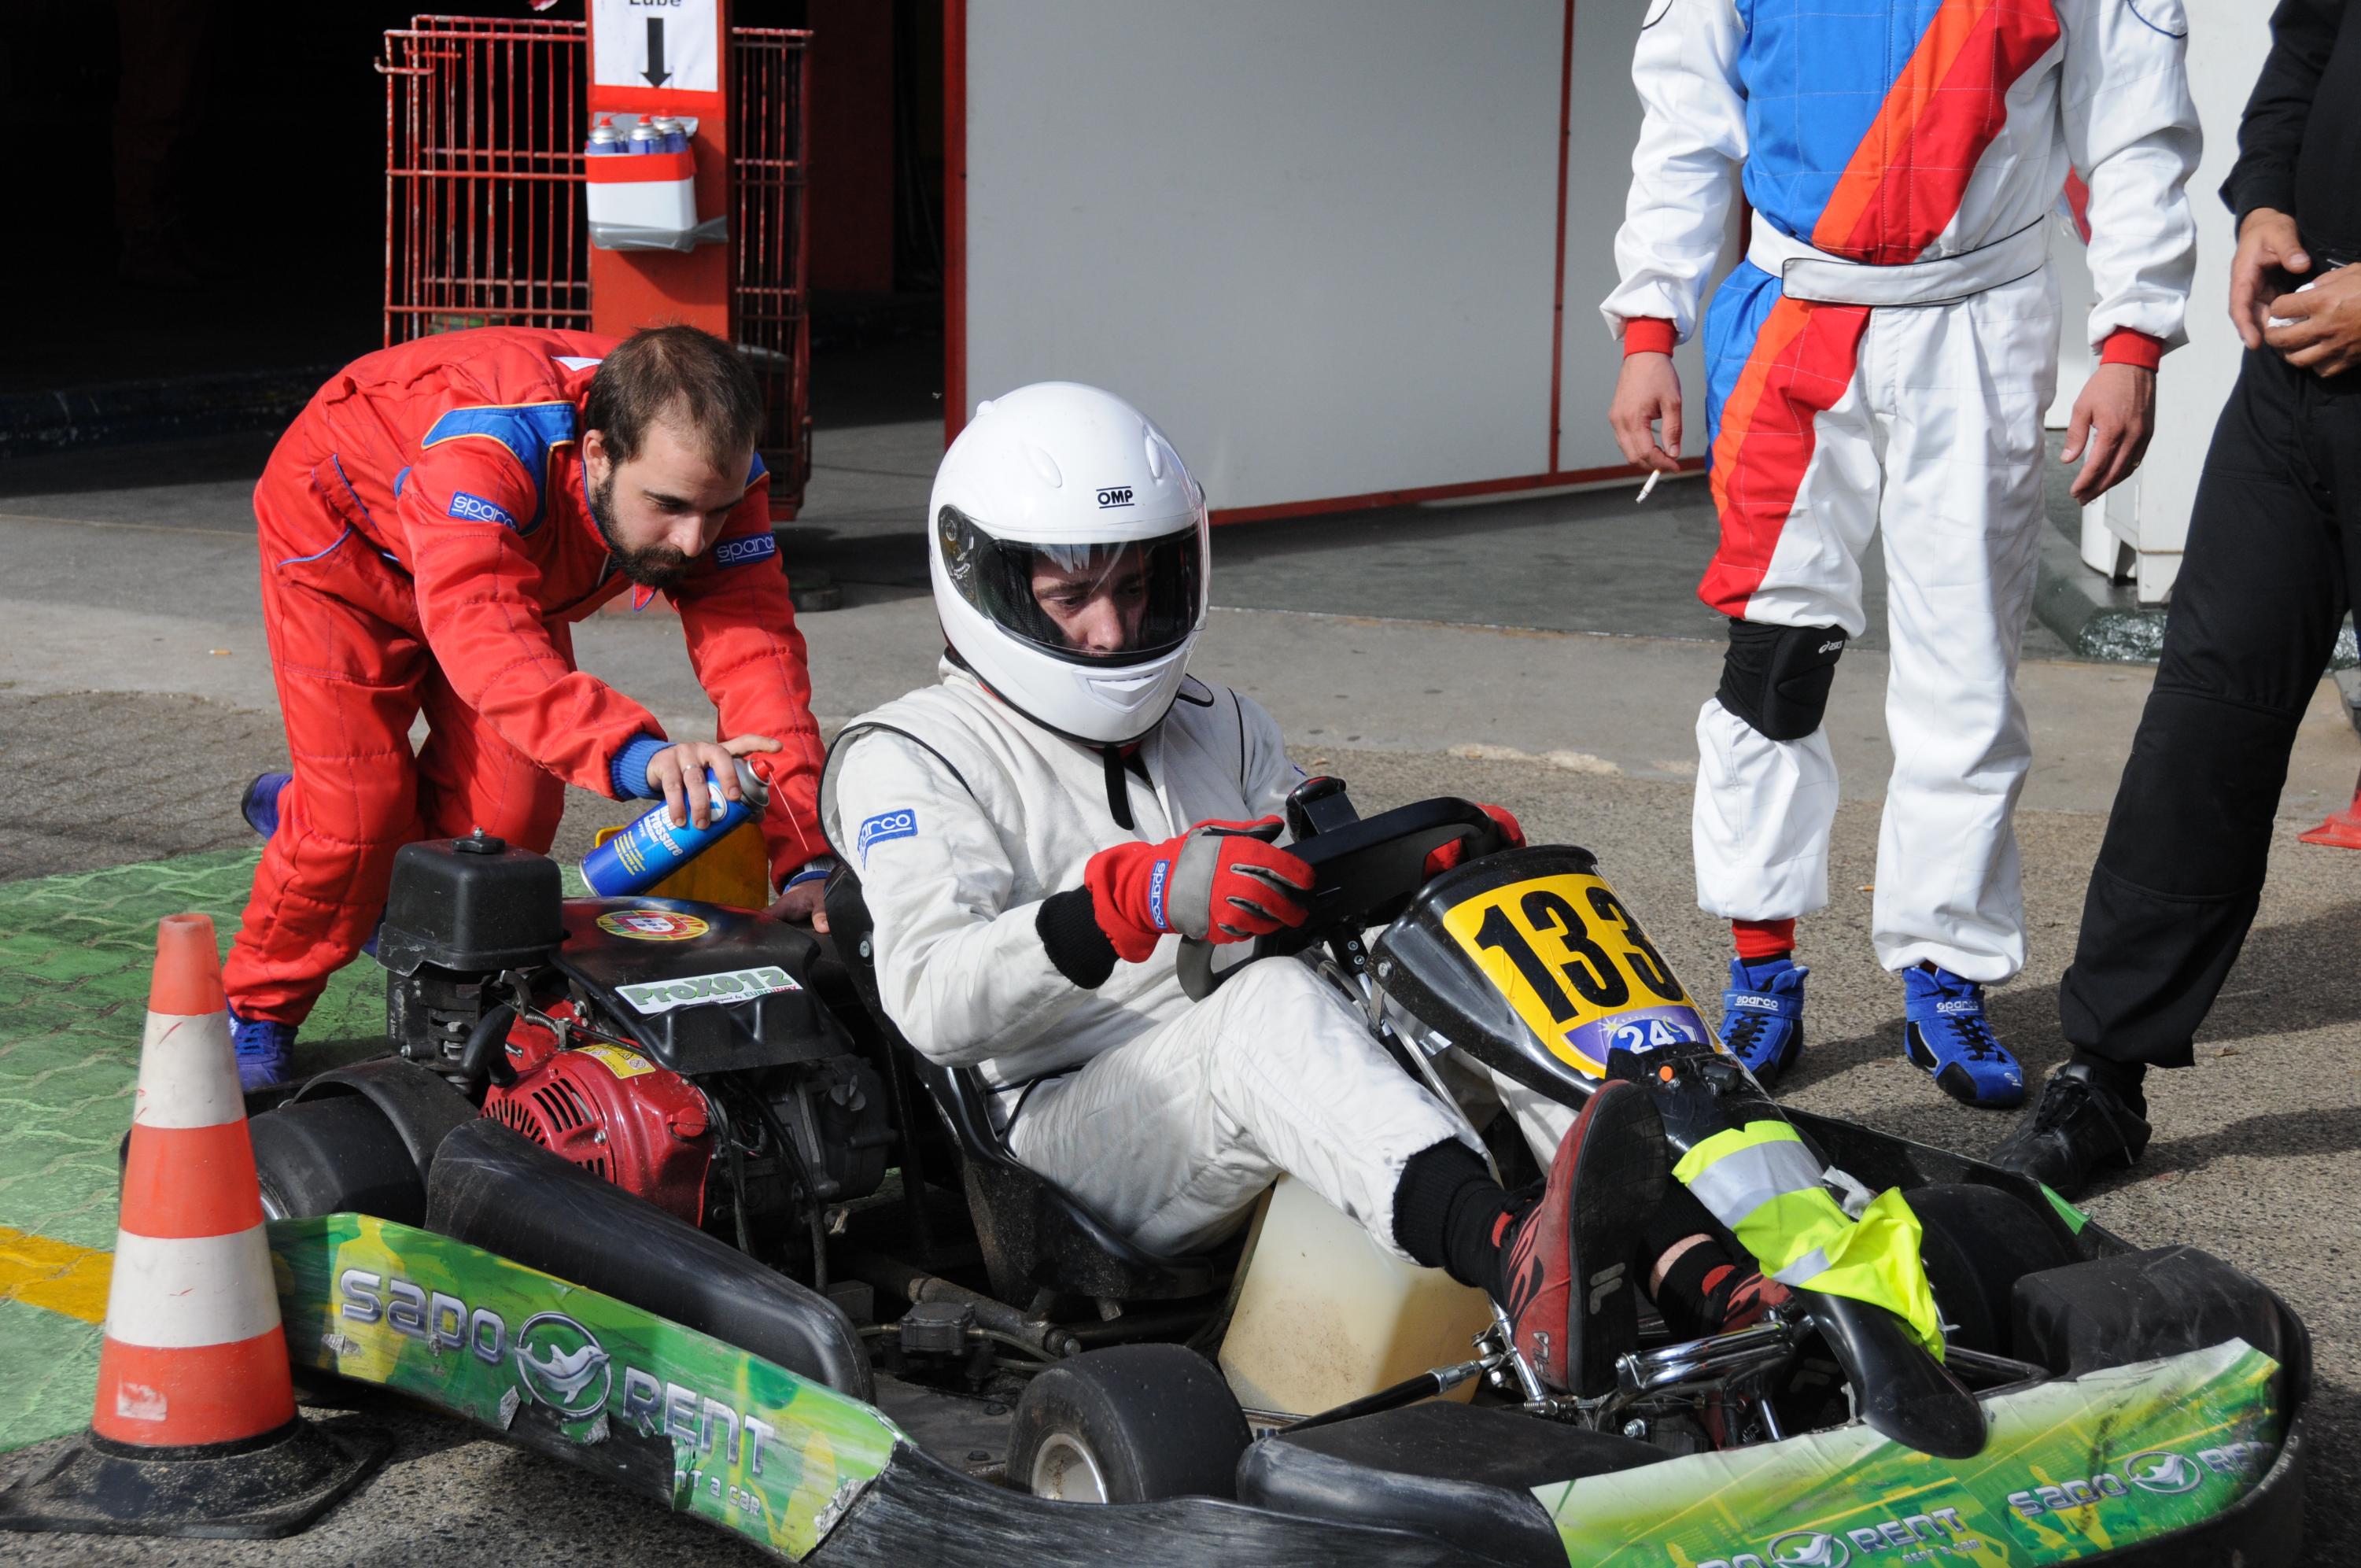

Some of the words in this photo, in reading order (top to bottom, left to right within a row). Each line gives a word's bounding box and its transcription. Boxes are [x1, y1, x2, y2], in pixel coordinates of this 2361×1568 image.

[452, 496, 516, 530] spar
[1097, 489, 1134, 505] OMP
[649, 810, 683, 856] Pressure
[1153, 862, 1165, 925] sparco
[1474, 887, 1684, 1024] 133
[1736, 995, 1779, 1011] sparco
[1618, 1020, 1677, 1054] 24
[2197, 1441, 2272, 1474] RE
